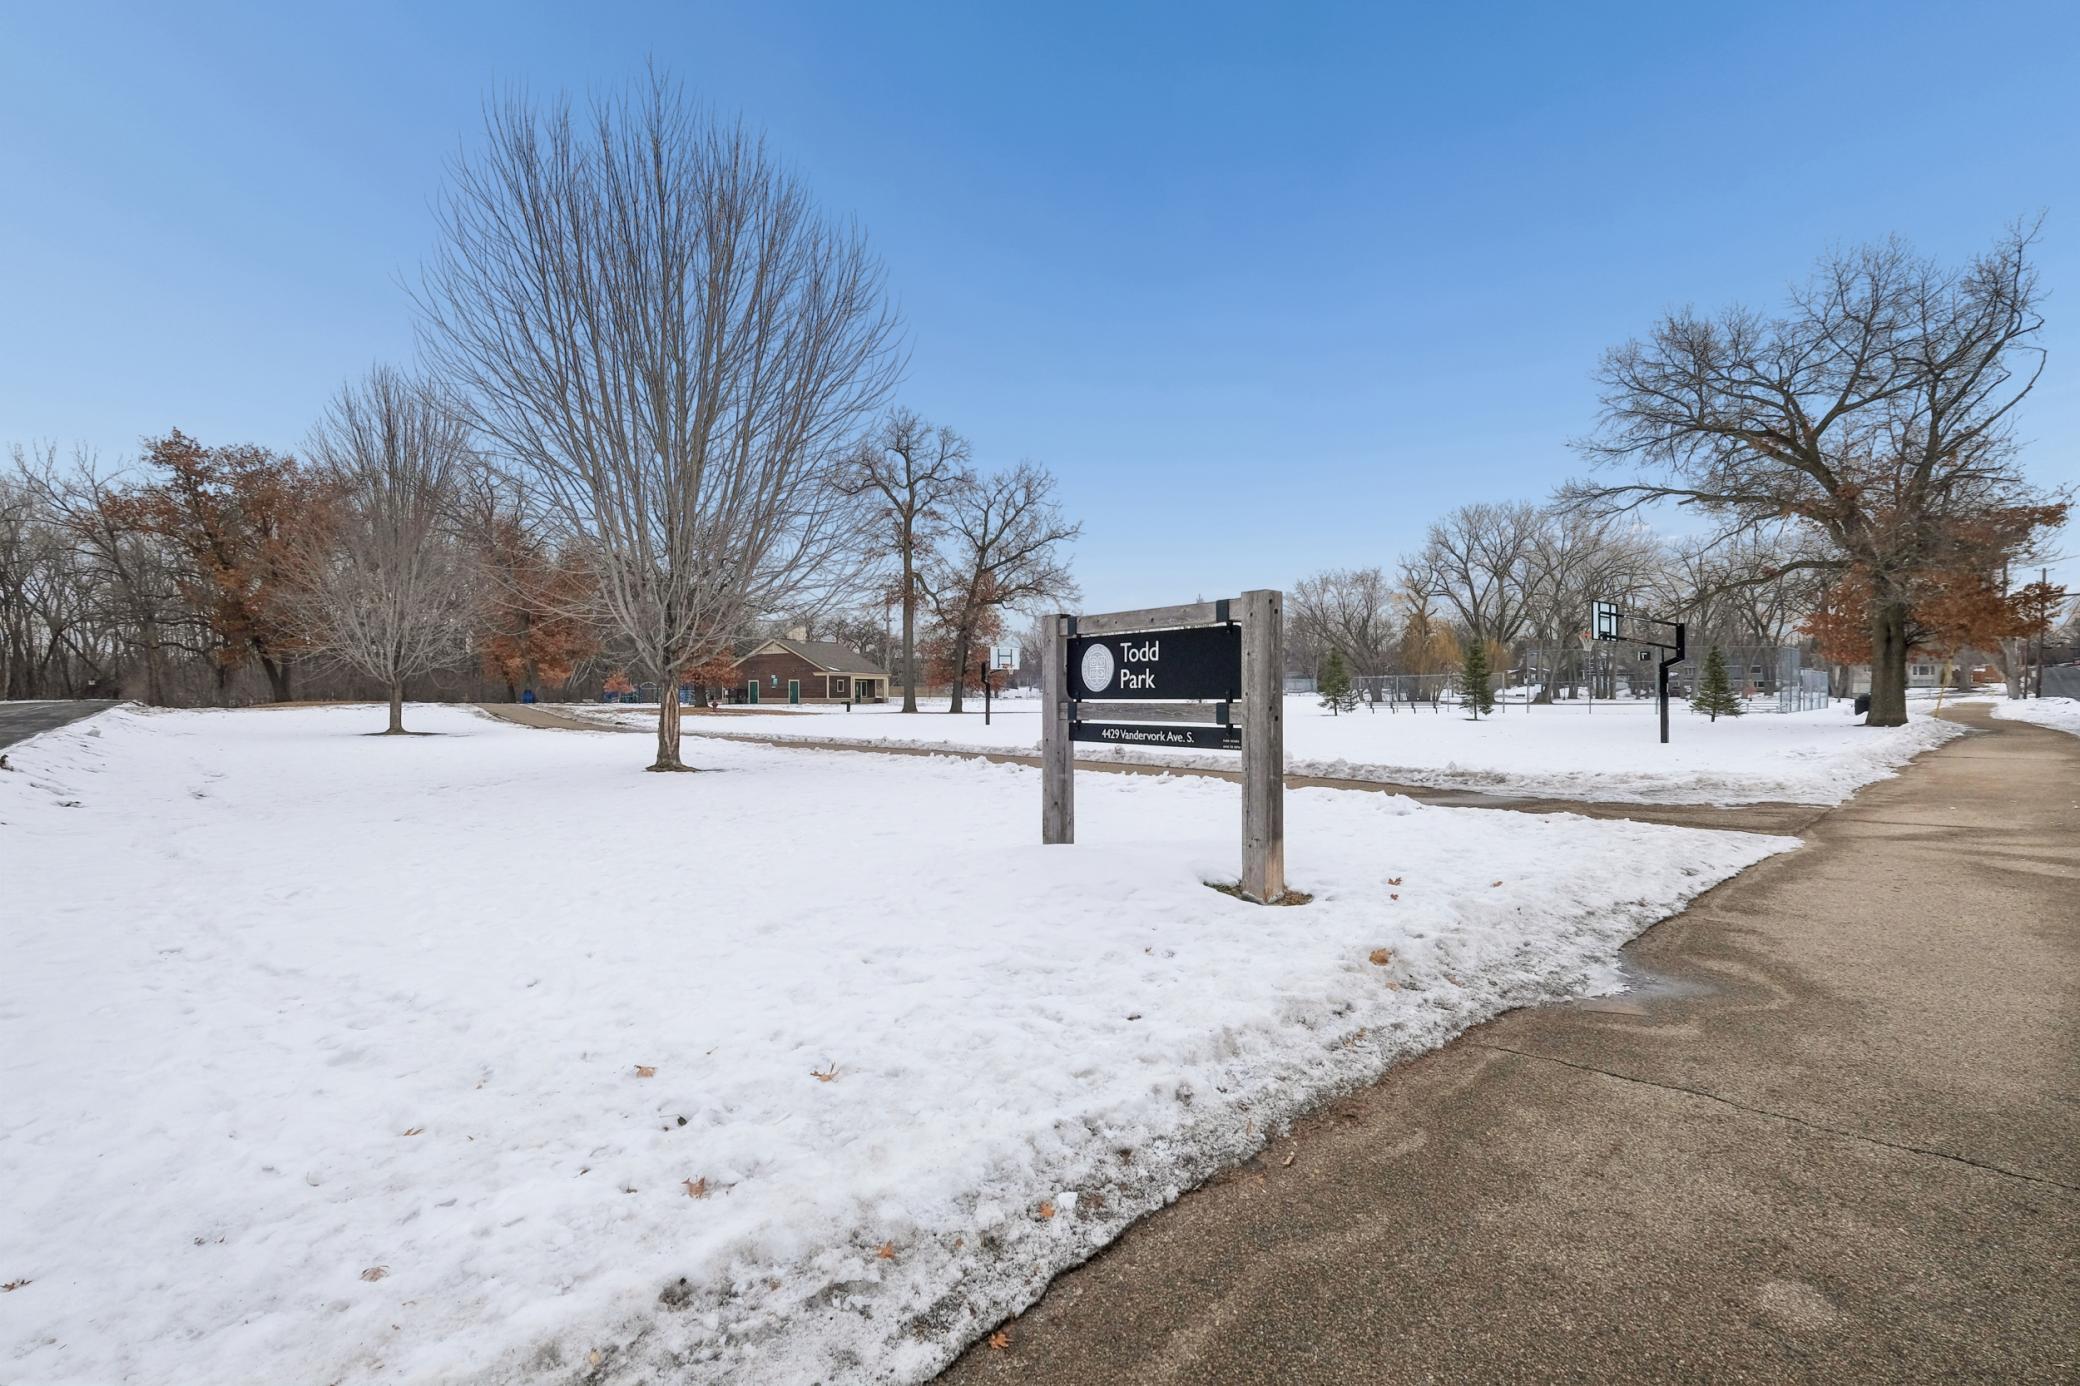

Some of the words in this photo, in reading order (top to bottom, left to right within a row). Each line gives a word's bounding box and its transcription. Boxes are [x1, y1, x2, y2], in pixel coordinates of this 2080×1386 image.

[1120, 640, 1159, 662] Todd
[1120, 668, 1156, 689] Park
[1102, 728, 1119, 739] 4429
[1120, 729, 1166, 741] Vandervork
[1166, 731, 1186, 742] Ave.
[1187, 731, 1195, 743] S.
